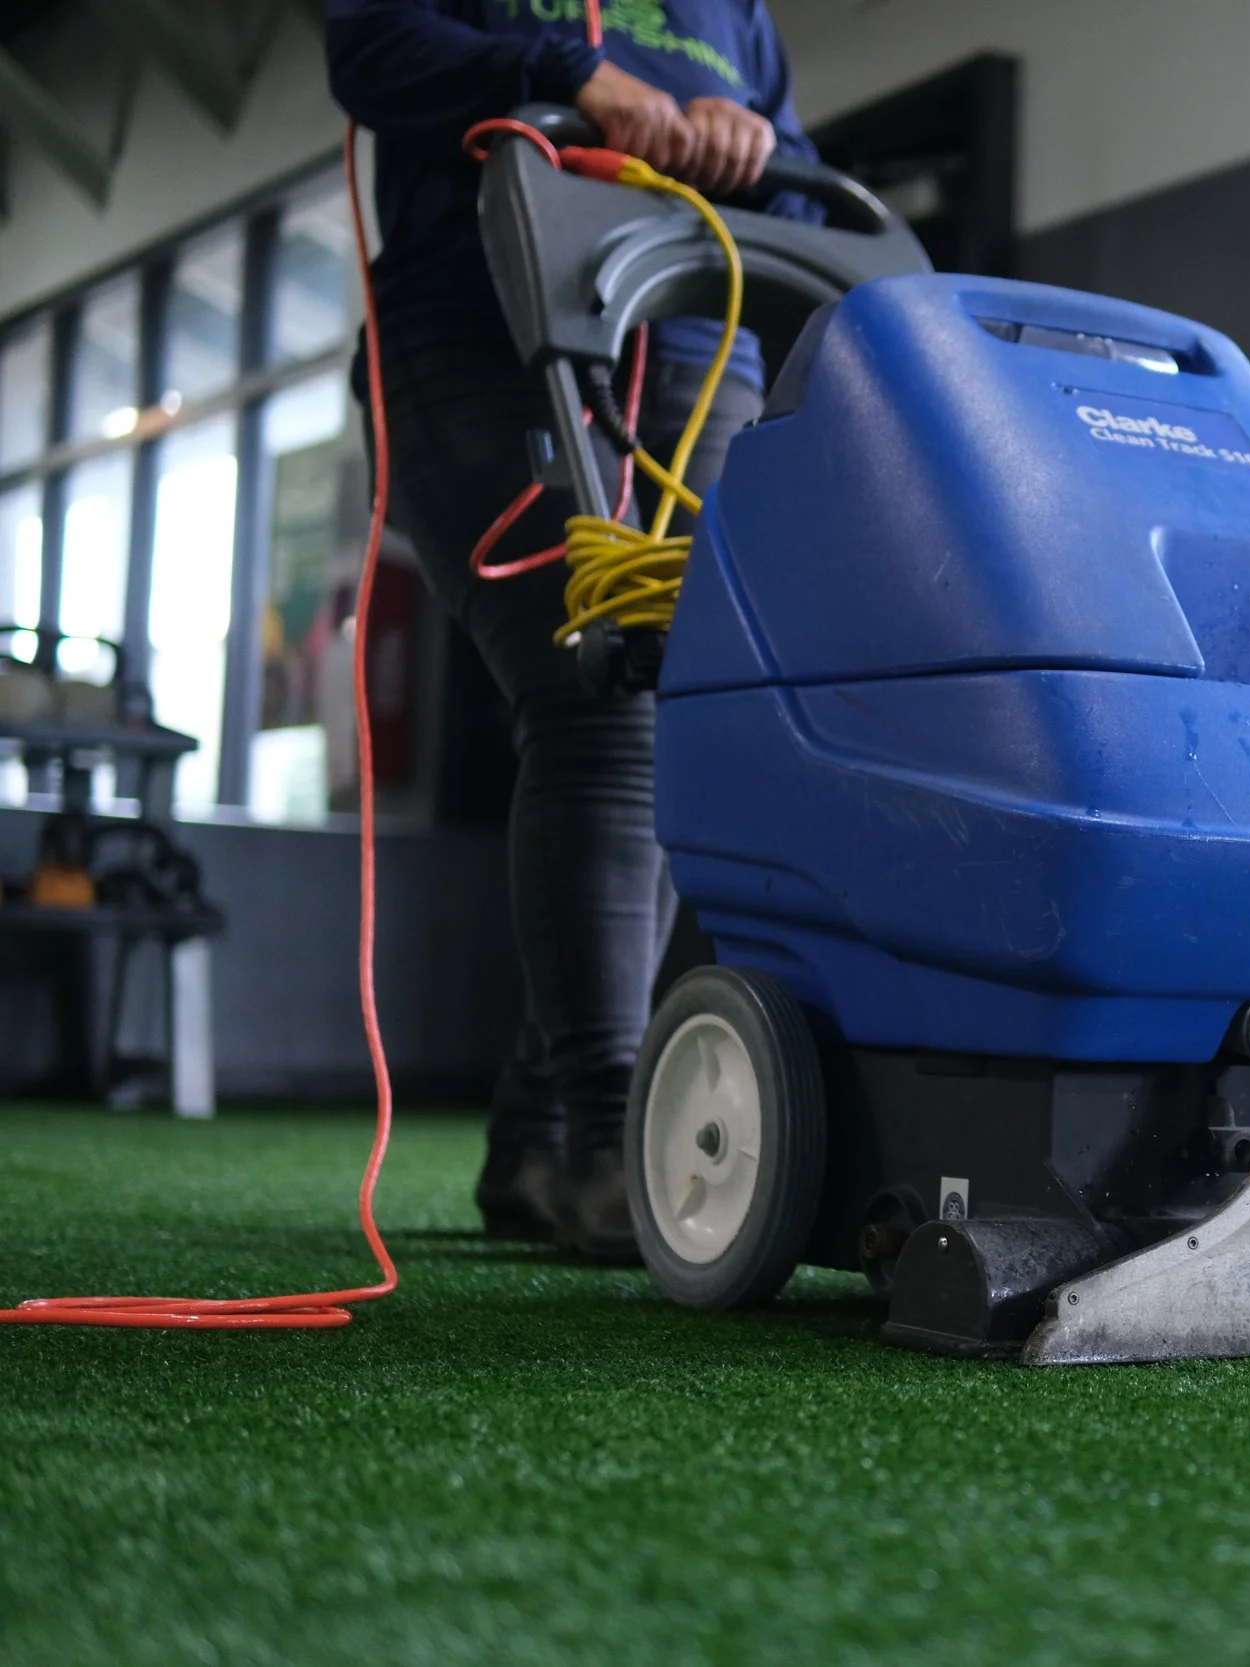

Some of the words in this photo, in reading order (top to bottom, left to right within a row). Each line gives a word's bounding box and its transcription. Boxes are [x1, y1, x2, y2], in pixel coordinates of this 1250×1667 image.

[1076, 405, 1198, 443] Clarke
[1089, 427, 1155, 448] Clean
[1155, 437, 1218, 459] Track
